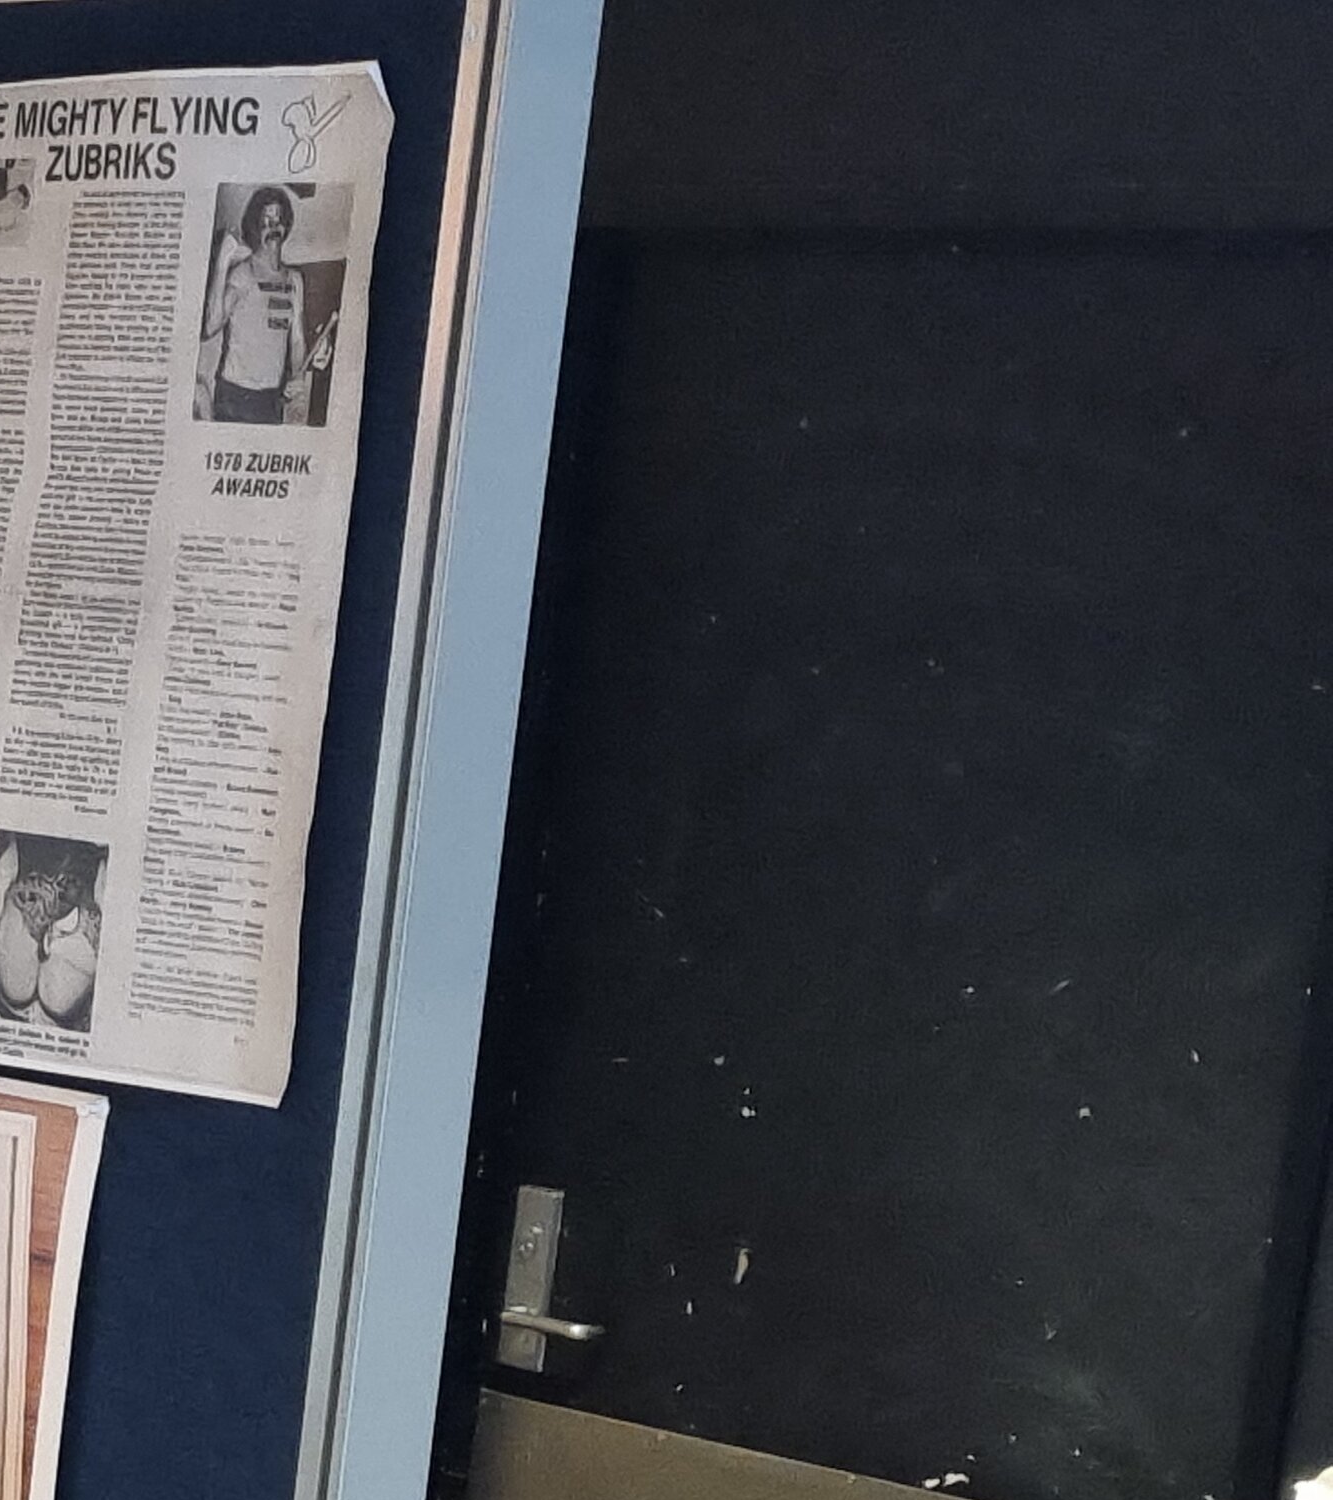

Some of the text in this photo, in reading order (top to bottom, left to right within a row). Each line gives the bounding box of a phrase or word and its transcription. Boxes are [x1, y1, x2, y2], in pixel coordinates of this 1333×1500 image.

[14, 98, 127, 138] MIGHTY
[132, 96, 260, 136] FLYING
[44, 142, 177, 182] ZUBRIKS
[245, 453, 312, 475] ZUBRIK
[211, 477, 289, 499] AWARDS
